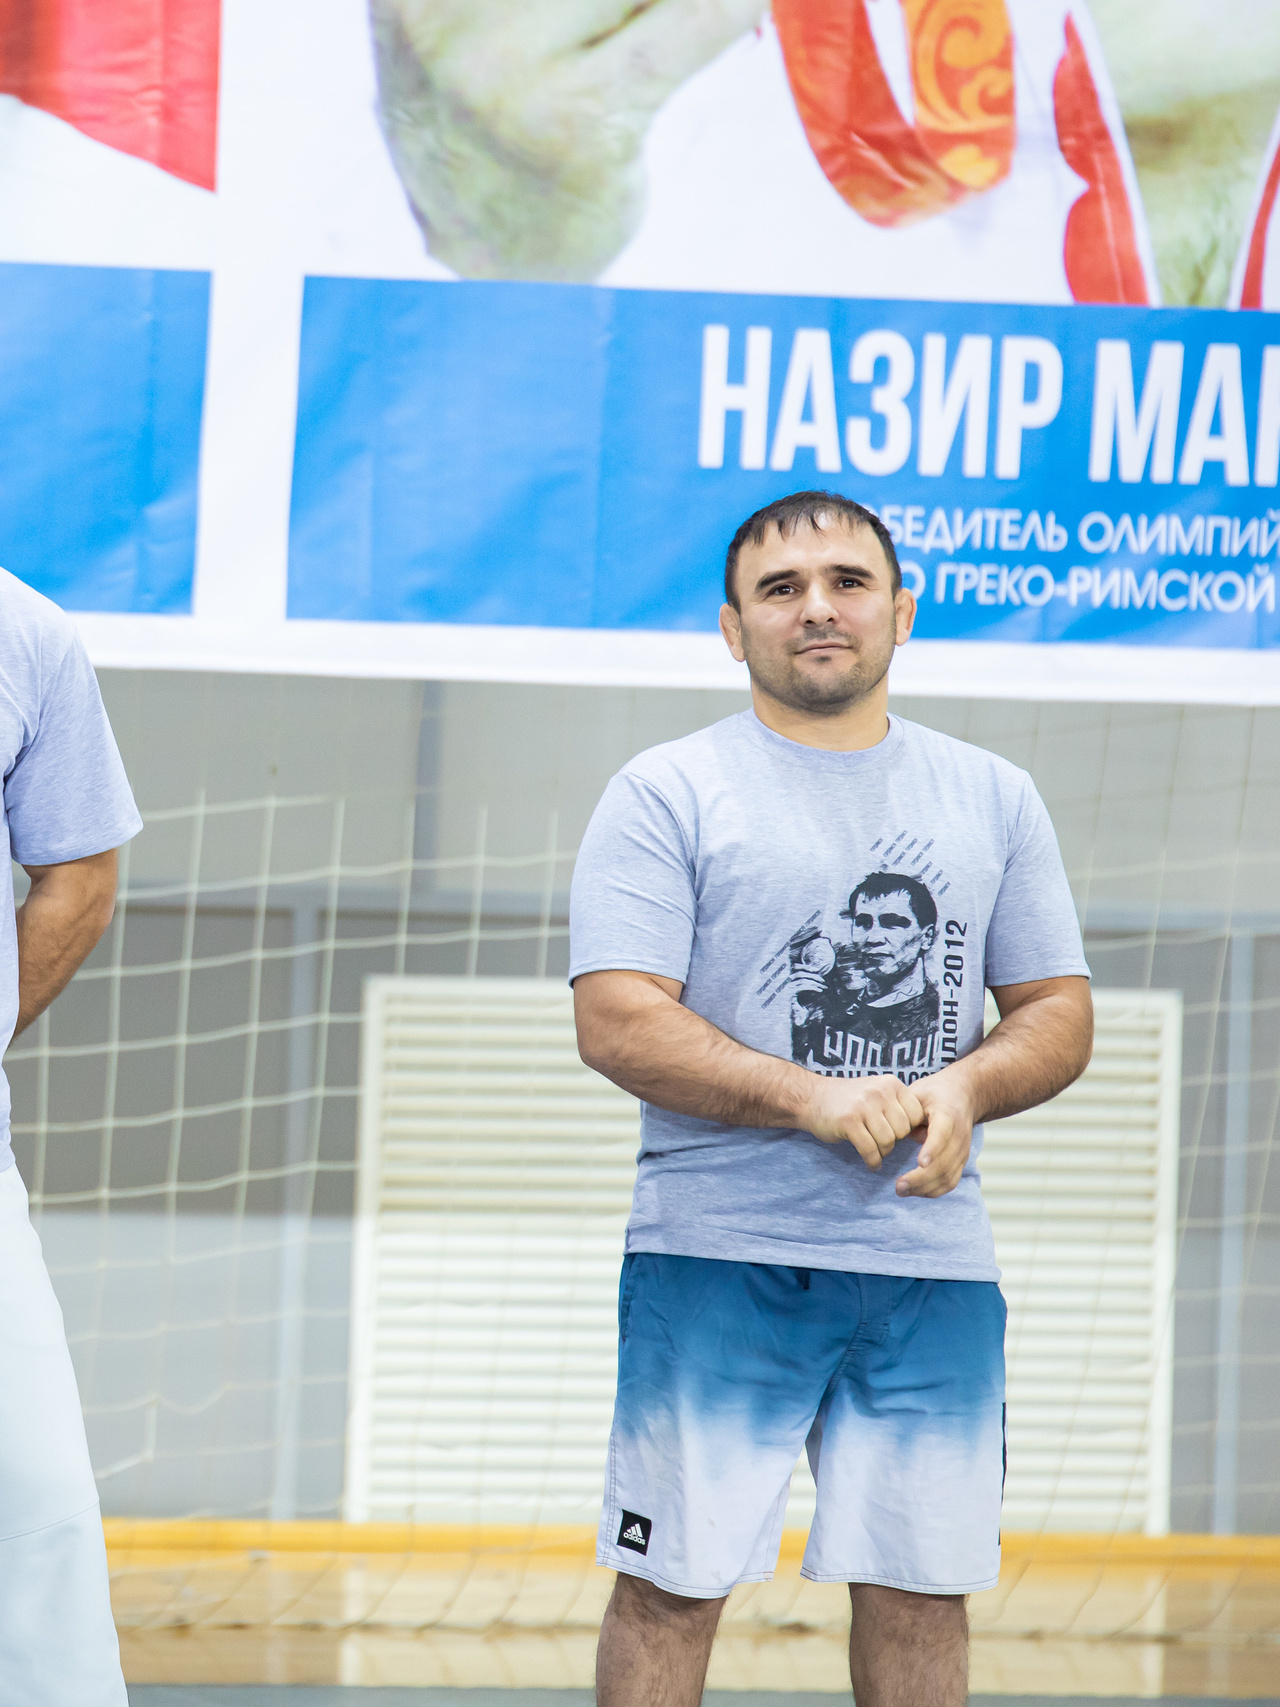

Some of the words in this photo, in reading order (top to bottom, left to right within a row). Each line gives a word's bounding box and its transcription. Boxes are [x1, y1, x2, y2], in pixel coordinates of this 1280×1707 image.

[698, 323, 1063, 480] НАЗИР
[864, 503, 1069, 556] БЕДИТЕЛЬ
[935, 562, 1276, 615] ГРЕКО-РИМСКОЙ
